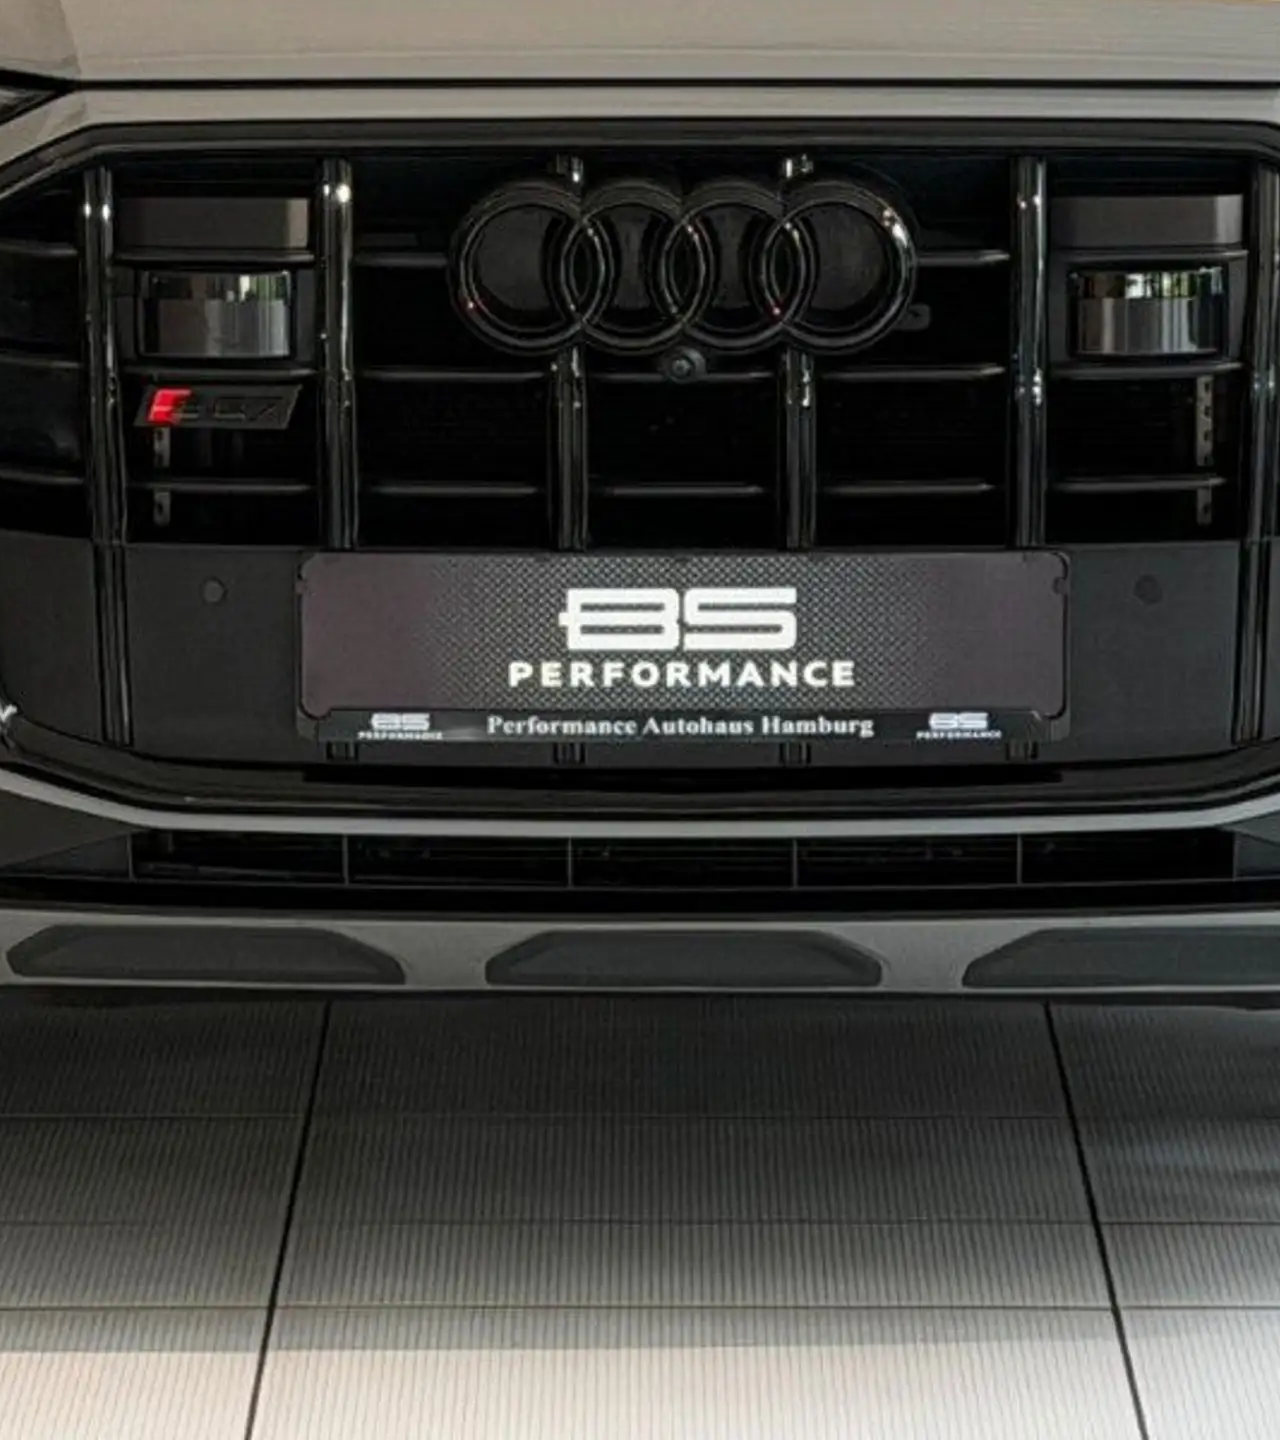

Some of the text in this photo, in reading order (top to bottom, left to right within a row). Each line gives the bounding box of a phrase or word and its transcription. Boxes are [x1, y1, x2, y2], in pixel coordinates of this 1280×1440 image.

[508, 659, 855, 688] PERFORMANCE
[487, 715, 875, 738] Performance Autohaus Hamburg
